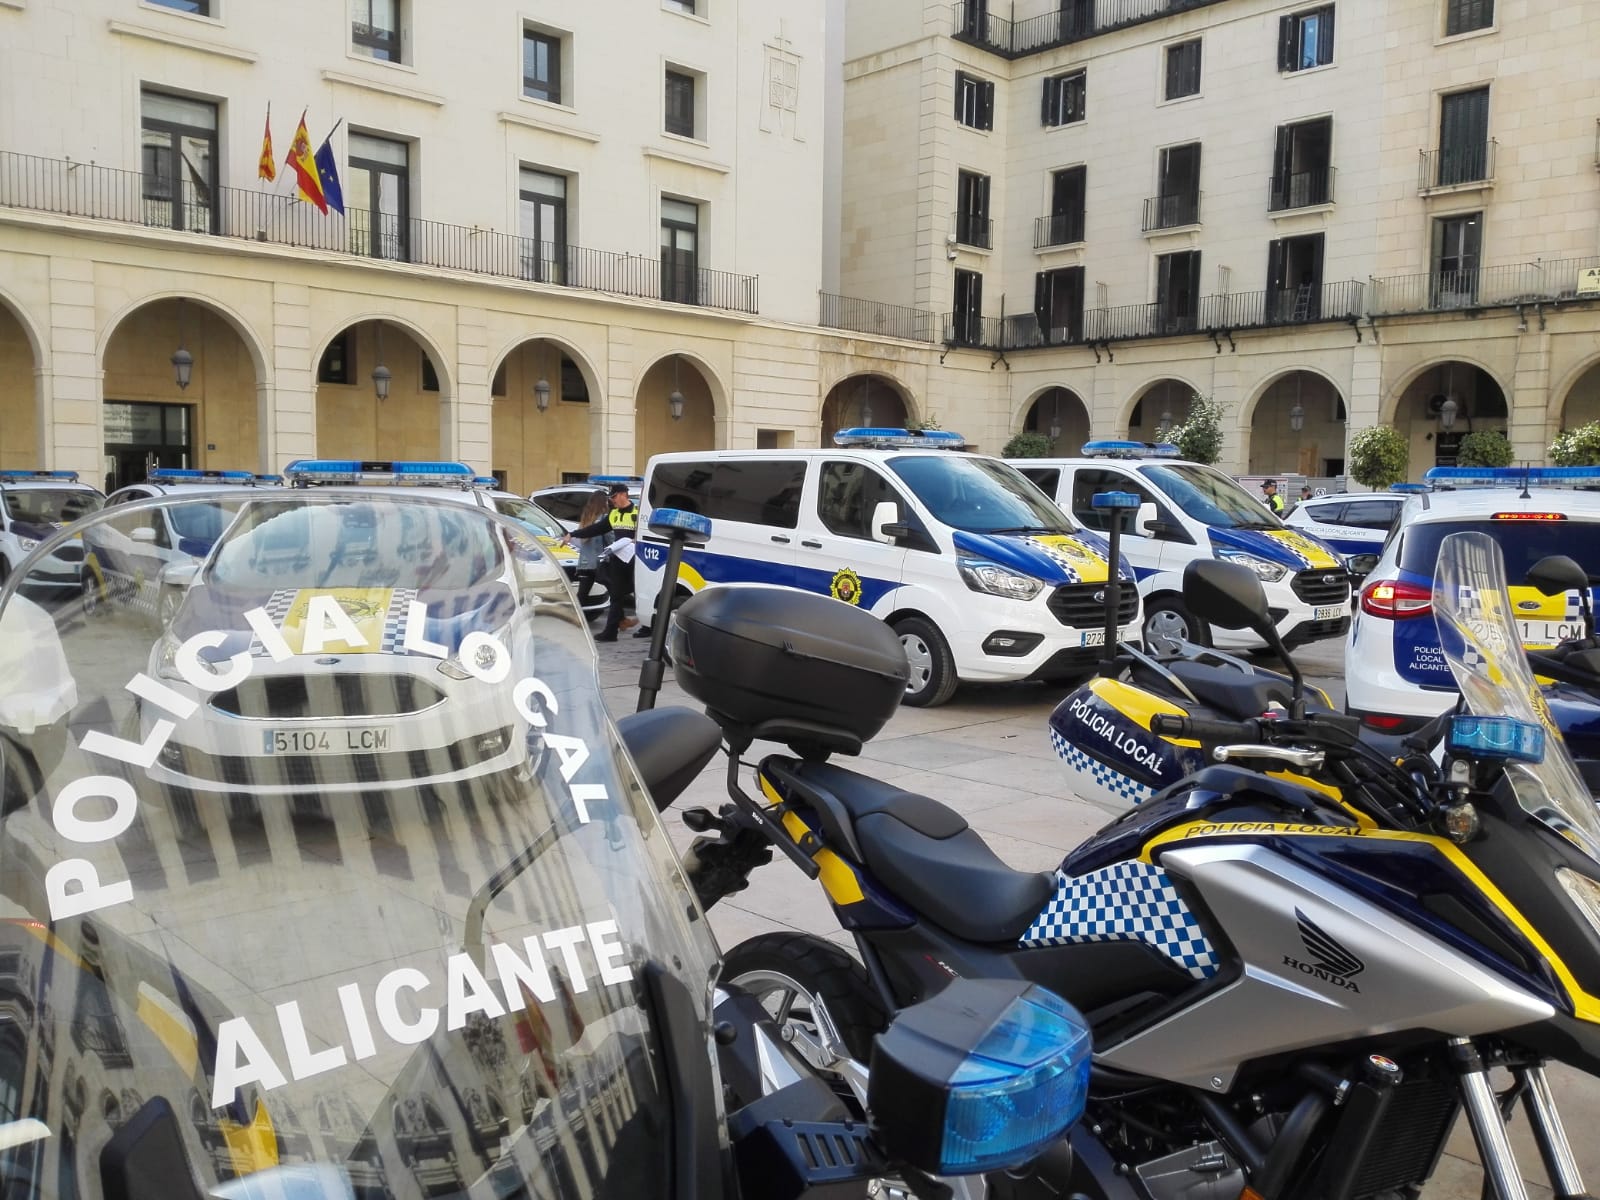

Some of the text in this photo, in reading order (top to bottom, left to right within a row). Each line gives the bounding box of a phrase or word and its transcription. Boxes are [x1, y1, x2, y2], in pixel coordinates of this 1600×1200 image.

[1545, 623, 1582, 640] LCM
[1409, 662, 1450, 672] ALICANTE
[1416, 654, 1443, 664] LOCAL
[275, 729, 387, 752] 5104 LCM
[1069, 698, 1163, 775] POLICIA LOCAL
[45, 595, 609, 921] POLICIA LOCAL
[1185, 823, 1368, 838] POLICIA LOCAL
[1282, 955, 1361, 994] HONDA
[211, 919, 633, 1110] ALICANTE
